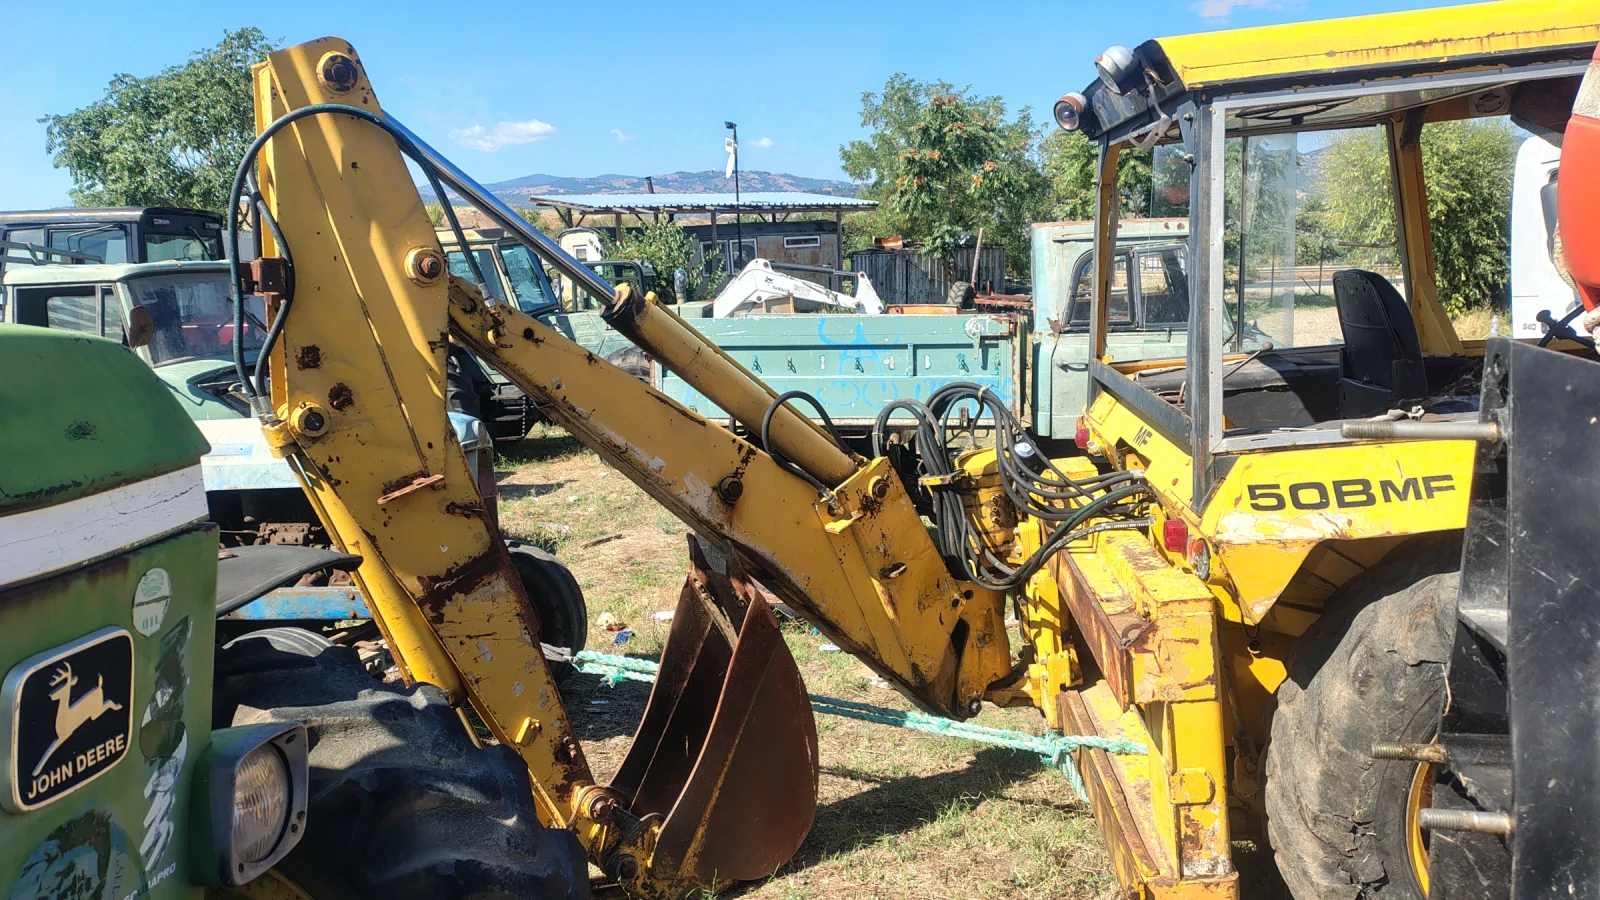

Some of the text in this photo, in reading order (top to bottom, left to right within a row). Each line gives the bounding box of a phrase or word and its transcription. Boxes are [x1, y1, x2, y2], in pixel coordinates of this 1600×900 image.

[1133, 426, 1153, 447] MF
[28, 733, 125, 799] JOHN DEERE
